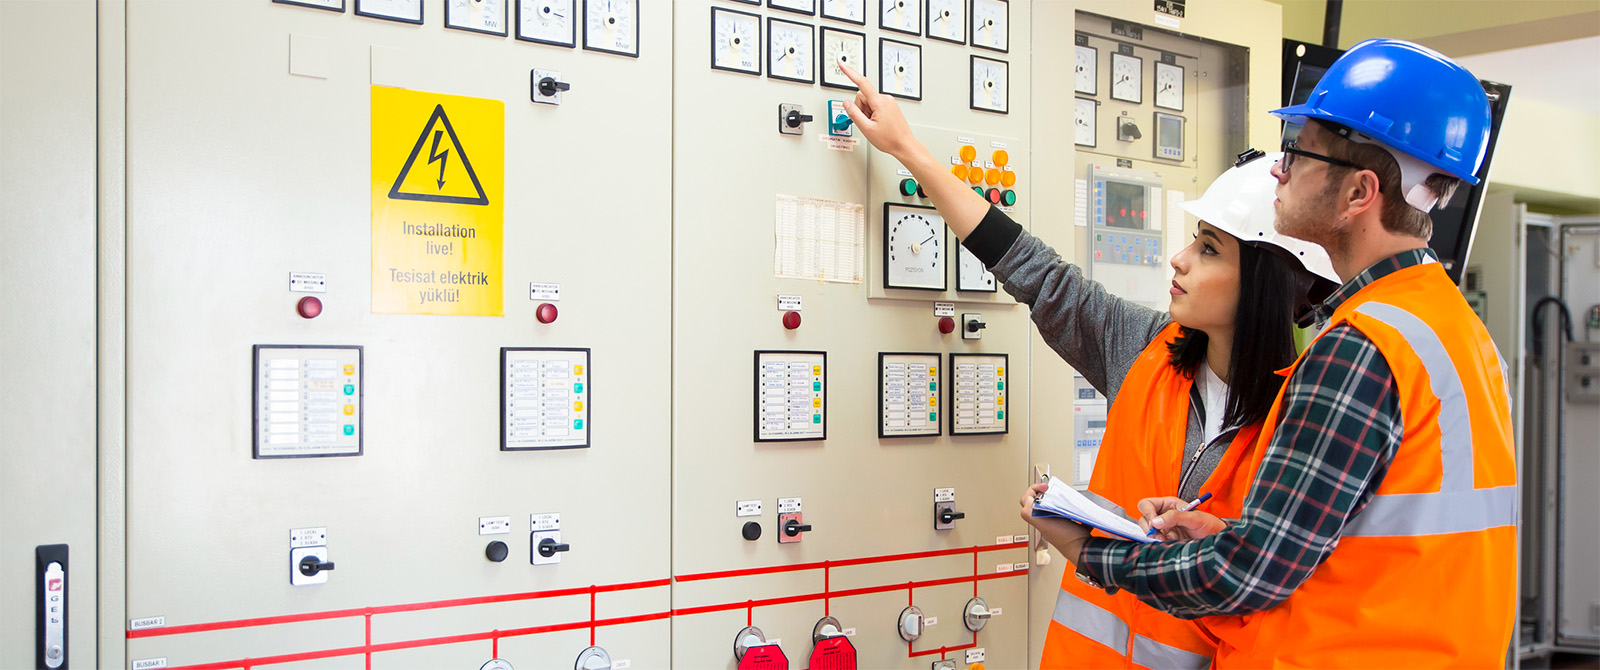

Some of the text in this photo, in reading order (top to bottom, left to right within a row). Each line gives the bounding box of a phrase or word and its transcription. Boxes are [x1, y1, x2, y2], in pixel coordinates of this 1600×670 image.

[484, 20, 498, 28] MW
[403, 220, 476, 239] Installation
[426, 240, 453, 255] live!
[389, 267, 489, 286] Tesisat elektrik
[419, 287, 460, 305] yüklü!
[134, 619, 158, 627] BUSBAR
[136, 660, 160, 668] BUSBAR
